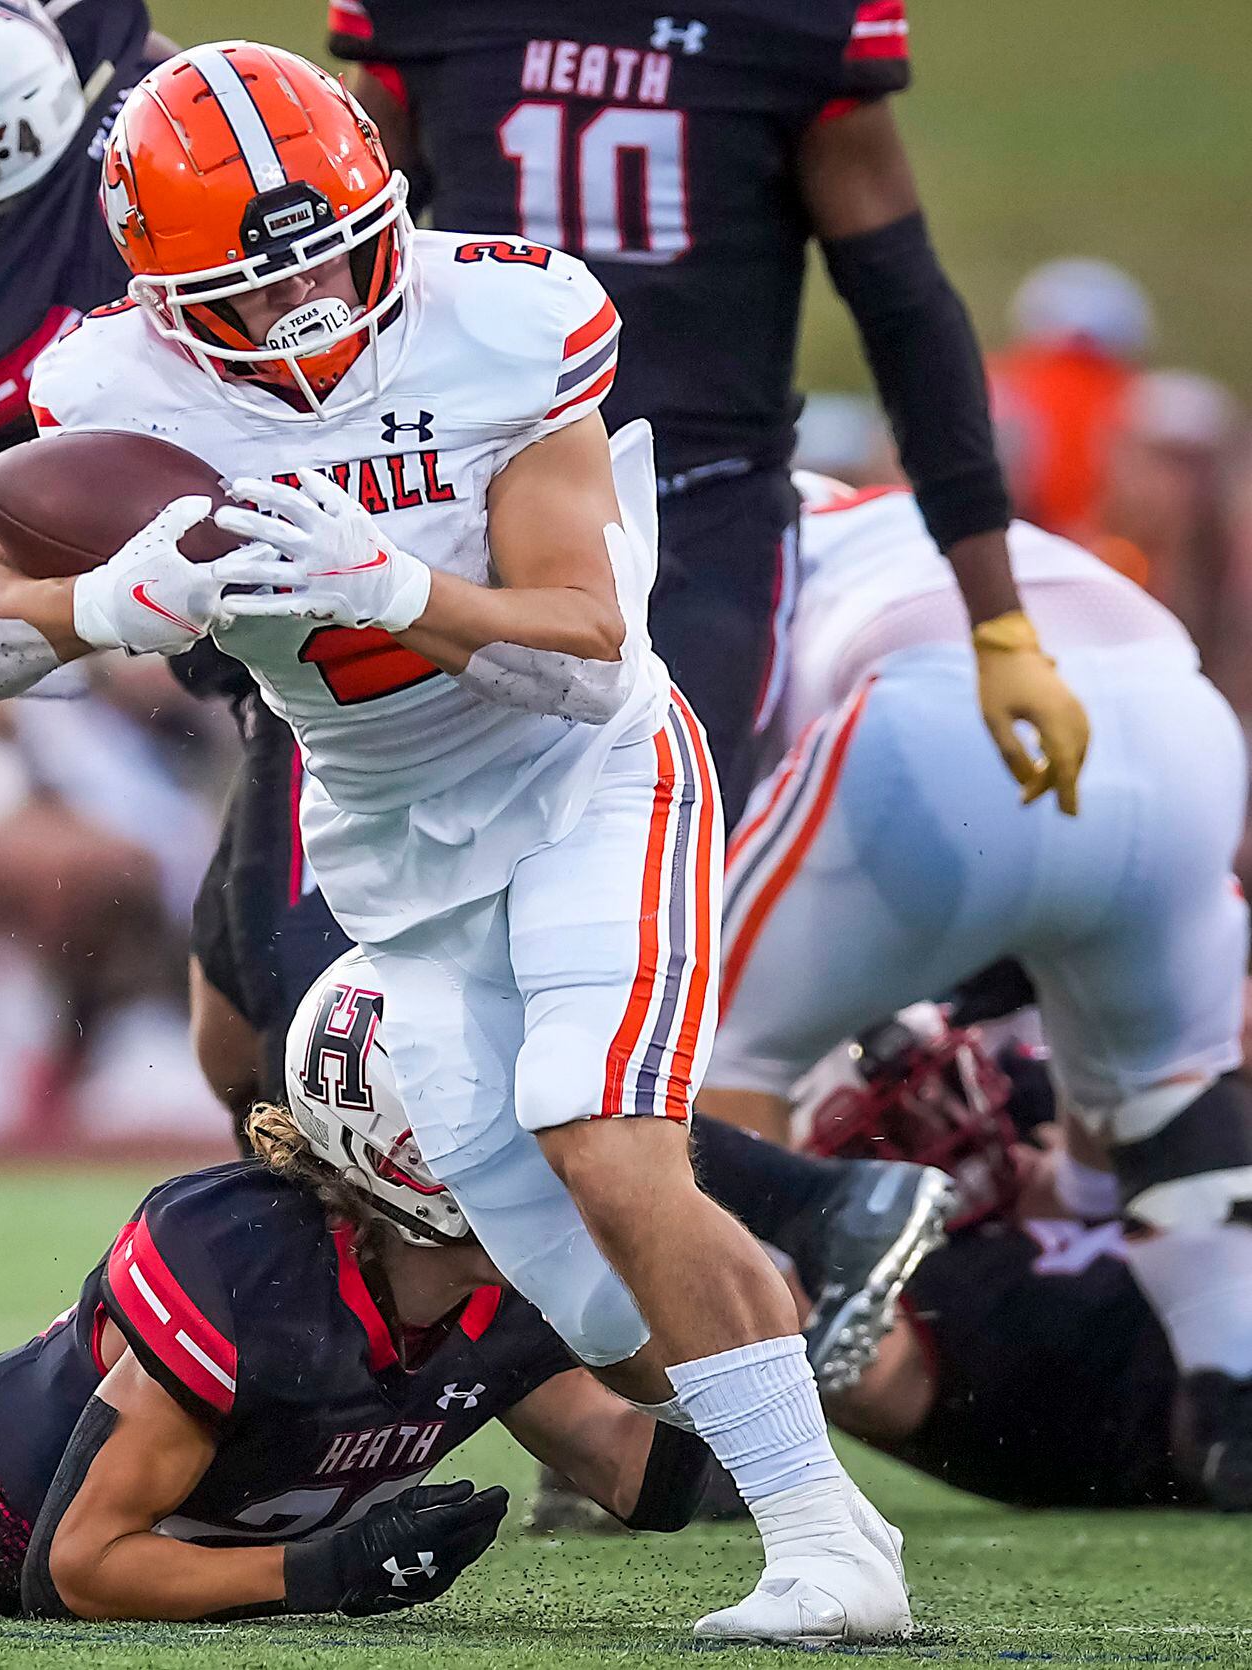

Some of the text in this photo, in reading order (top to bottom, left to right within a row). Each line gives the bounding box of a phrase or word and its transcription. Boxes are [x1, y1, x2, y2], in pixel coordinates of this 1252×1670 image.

[521, 38, 672, 103] HEATH
[497, 100, 695, 264] 10
[454, 241, 551, 270] 2
[289, 307, 320, 328] TEXAS
[300, 984, 384, 1112] H
[312, 1420, 446, 1476] HEATH
